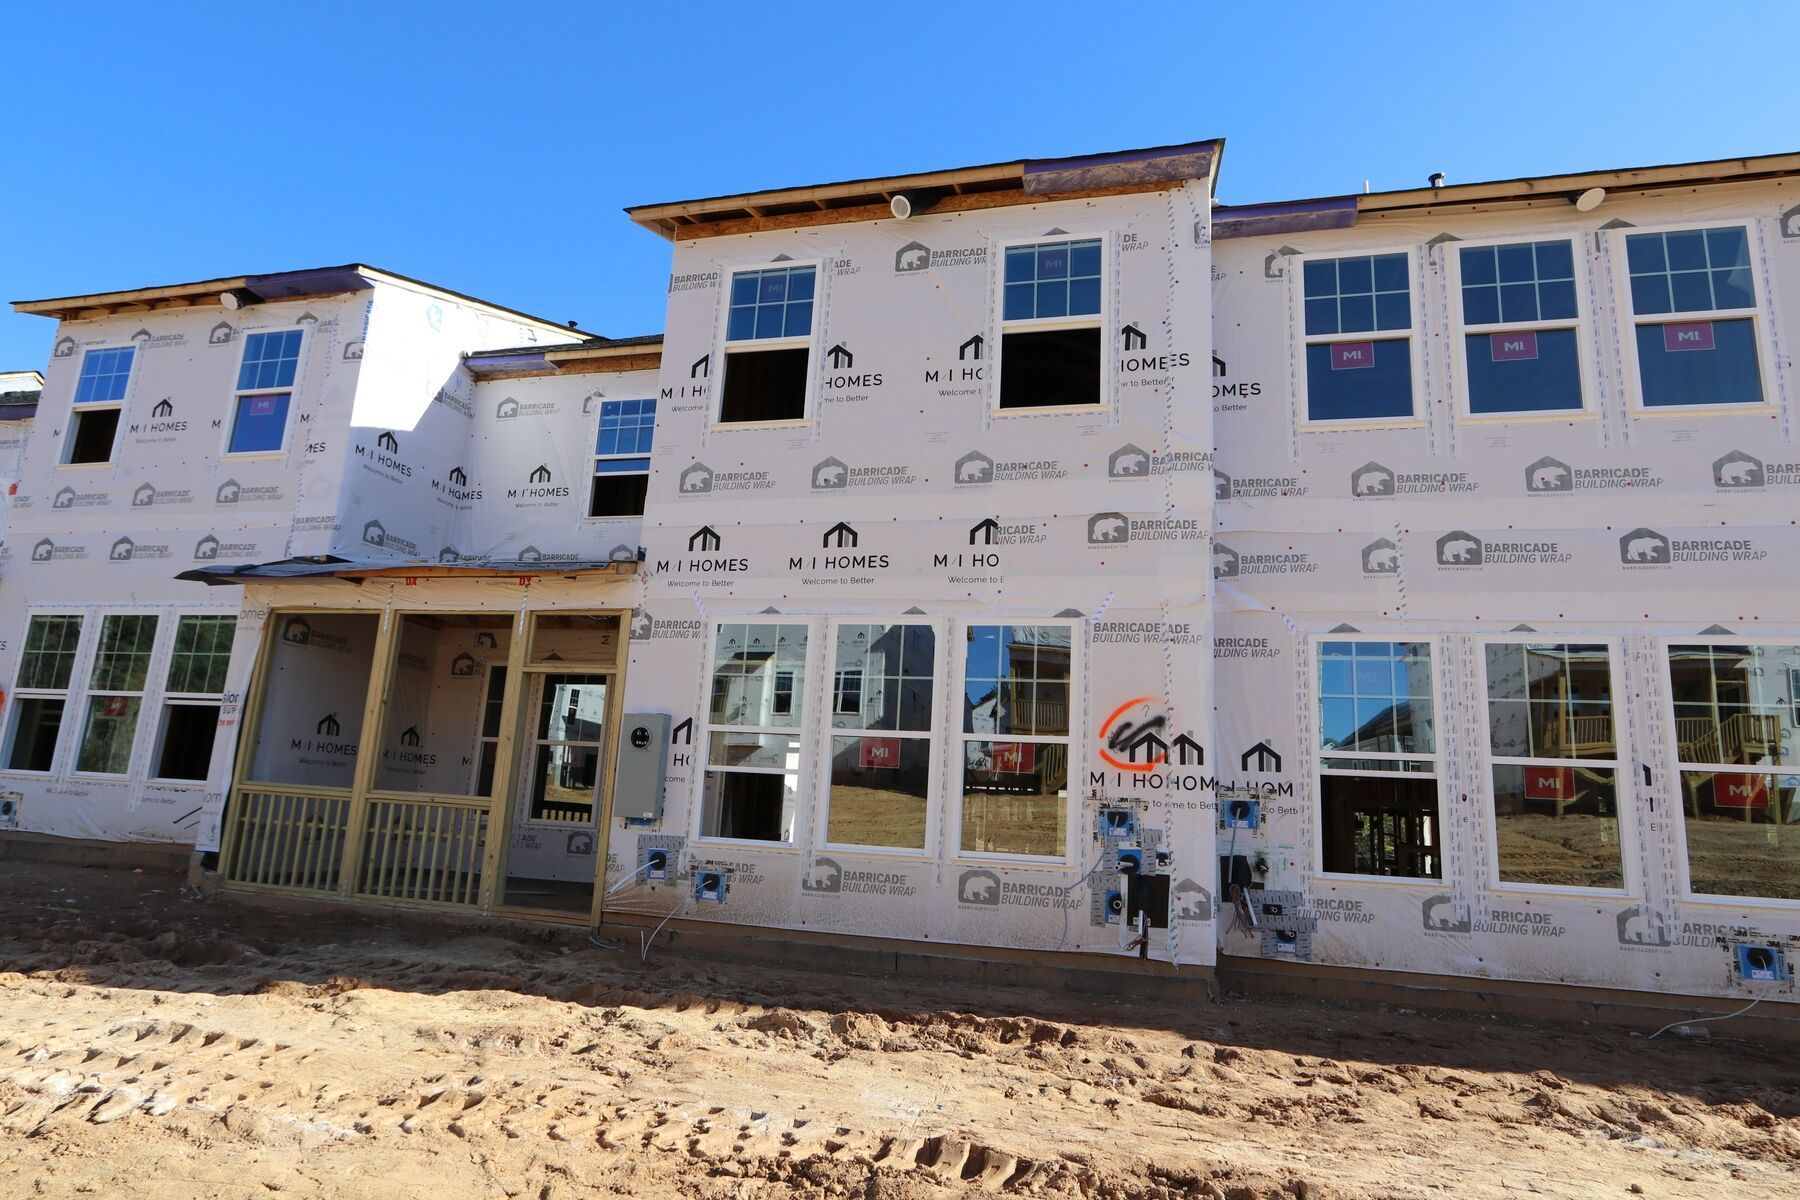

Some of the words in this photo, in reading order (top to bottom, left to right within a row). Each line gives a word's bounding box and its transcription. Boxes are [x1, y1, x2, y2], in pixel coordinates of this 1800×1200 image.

[1121, 242, 1149, 252] WRAP
[930, 256, 972, 267] BUILDING
[837, 264, 861, 277] WRAP
[938, 389, 978, 398] Welcome
[519, 402, 555, 411] BARRICADE
[1221, 404, 1247, 412] Better
[150, 421, 188, 433] HOMES
[377, 455, 412, 478] HOMES
[849, 466, 907, 477] BARRICADE
[995, 461, 1058, 472] BARRICADE
[714, 471, 768, 482] BARRICADE
[994, 472, 1039, 481] BUILDING
[1041, 470, 1068, 479] WRAP
[1396, 473, 1468, 484] BARRICADE
[1574, 468, 1649, 479] BARRICADE
[712, 481, 750, 491] BUILDING
[752, 481, 777, 490] WRAP
[848, 477, 890, 487] BUILDING
[891, 475, 917, 485] WRAP
[1232, 478, 1297, 488] BARRICADE
[1574, 479, 1628, 489] BUILDING
[1630, 477, 1664, 488] WRAP
[448, 486, 483, 501] HOMES
[529, 487, 570, 498] HOMES
[1232, 487, 1278, 498] BUILDING
[1279, 487, 1309, 497] WRAP
[1396, 483, 1446, 494] BUILDING
[1449, 482, 1479, 493] WRAP
[1131, 520, 1198, 530] BARRICADE
[1019, 535, 1047, 544] WRAP
[1130, 530, 1179, 541] BUILDING
[1180, 530, 1209, 540] WRAP
[1484, 543, 1558, 553] BARRICADE
[1671, 540, 1752, 551] BARRICADE
[1241, 554, 1308, 565] BARRICADE
[1484, 554, 1539, 564] BUILDING
[1540, 553, 1572, 563] WRAP
[1672, 551, 1729, 562] BUILDING
[1732, 550, 1768, 561] WRAP
[689, 558, 749, 572] HOMES
[824, 555, 890, 569] HOMES
[1240, 564, 1287, 575] BUILDING
[1289, 563, 1319, 573] WRAP
[668, 580, 701, 588] Welcome
[711, 579, 734, 587] Better
[802, 577, 838, 586] Welcome
[850, 577, 875, 586] Better
[948, 575, 988, 584] Welcome
[989, 575, 999, 583] to
[652, 629, 690, 639] BUILDING
[1092, 632, 1141, 644] BUILDING
[1251, 647, 1281, 658] WRAP
[316, 741, 358, 757] HOMES
[871, 747, 889, 758] MI
[1538, 778, 1560, 789] MI
[843, 870, 907, 885] BARRICADE
[841, 882, 888, 896] BUILDING
[889, 885, 918, 898] WRAP
[1002, 882, 1071, 900] BARRICADE
[1001, 894, 1050, 909] BUILDING
[1052, 897, 1083, 912] WRAP
[1344, 911, 1376, 924] WRAP
[1534, 924, 1566, 938] WRAP
